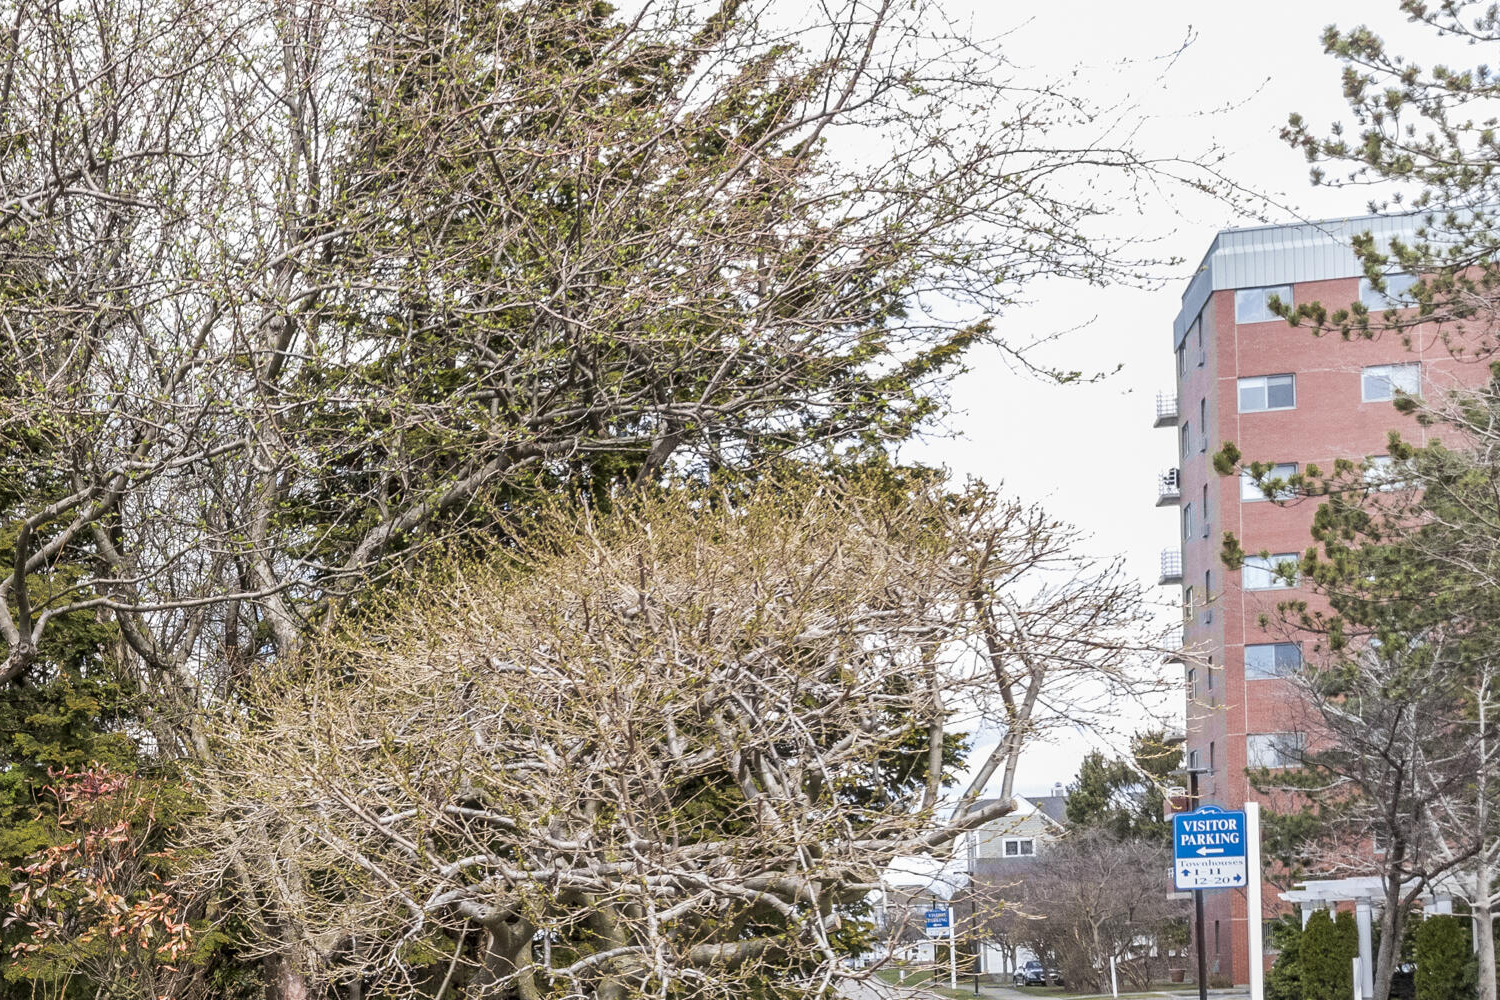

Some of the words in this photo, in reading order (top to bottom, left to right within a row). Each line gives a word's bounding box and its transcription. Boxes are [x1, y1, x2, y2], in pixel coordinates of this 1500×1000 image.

[1182, 819, 1238, 832] VISITOR
[1180, 832, 1240, 846] PARKING
[1180, 859, 1244, 867] Townhouses
